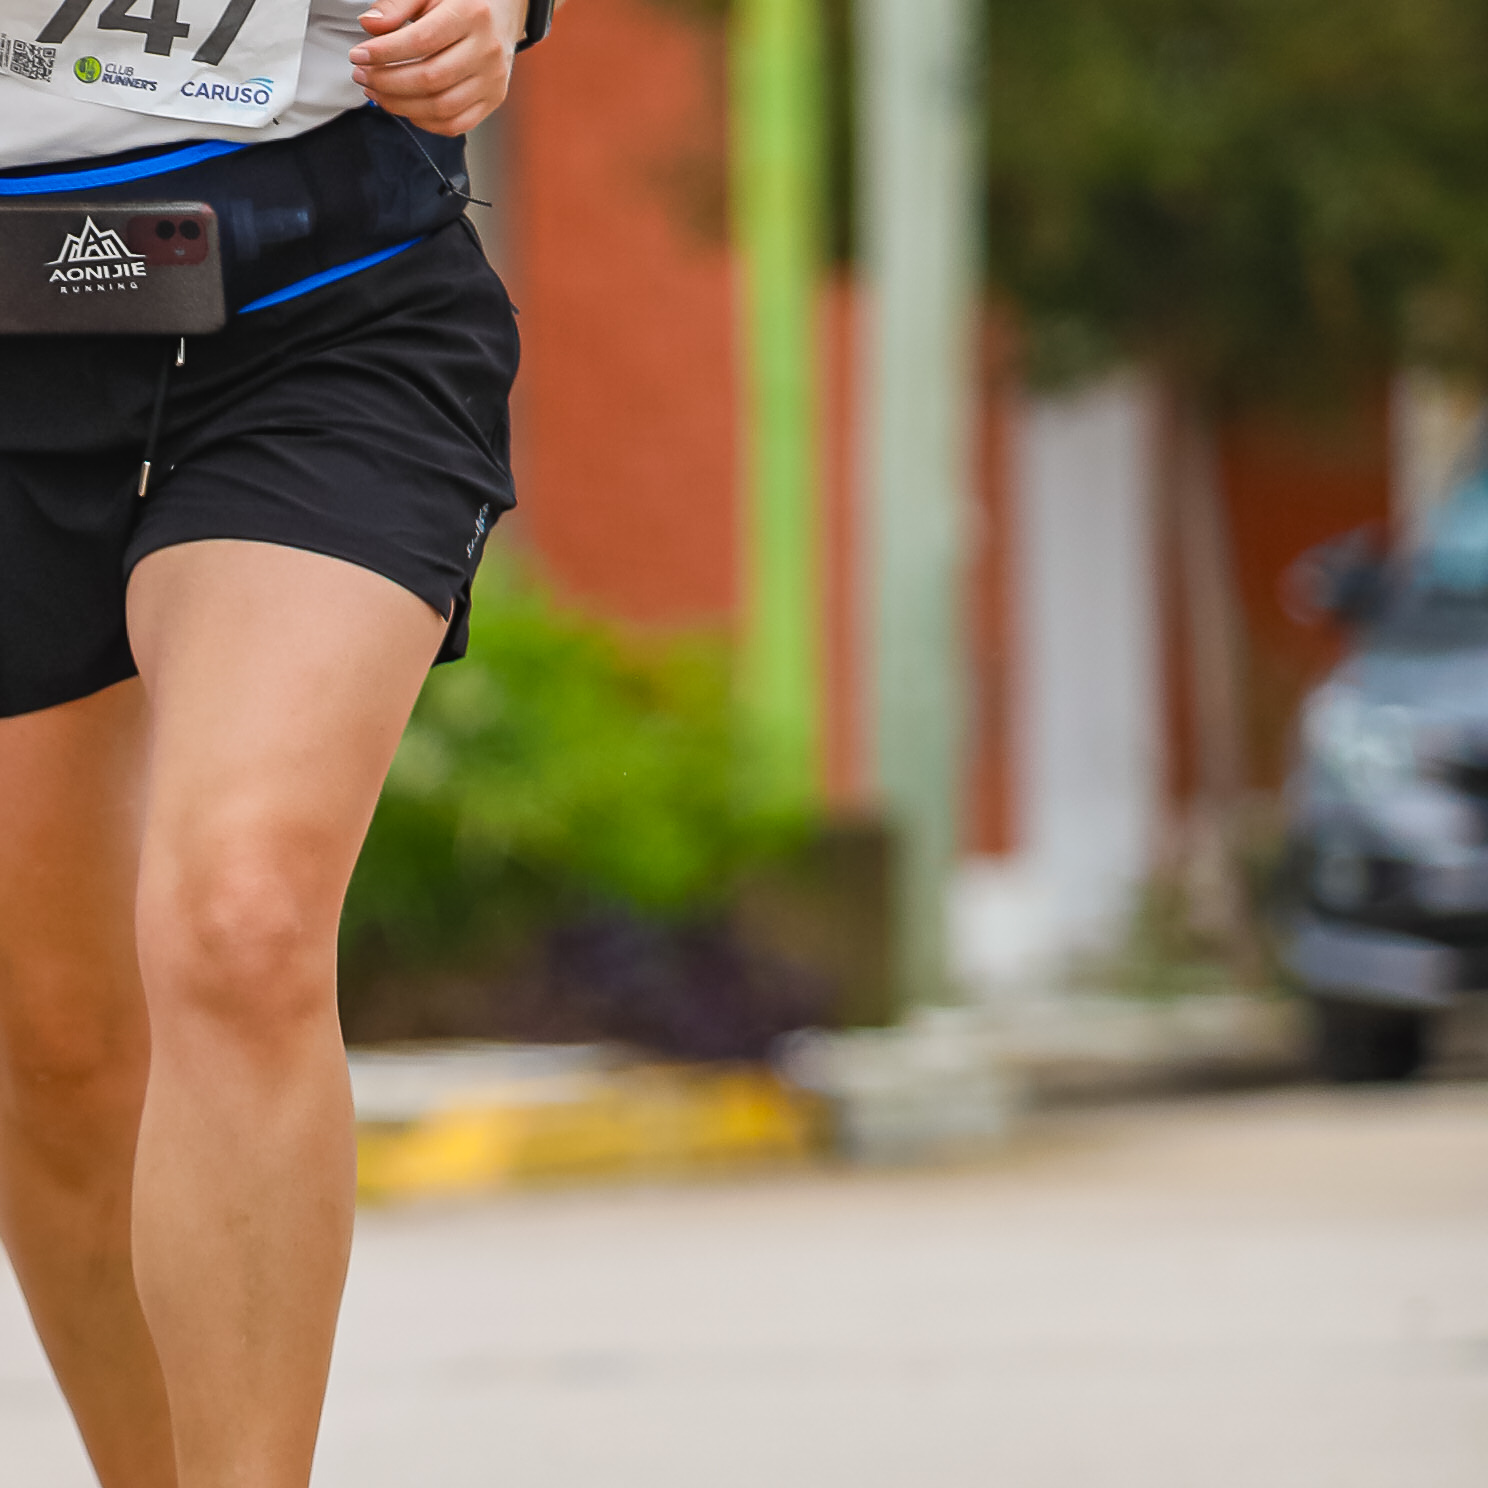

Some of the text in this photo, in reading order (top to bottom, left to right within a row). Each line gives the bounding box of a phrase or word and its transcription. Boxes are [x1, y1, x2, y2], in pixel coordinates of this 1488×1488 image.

[105, 63, 134, 76] CLUB
[181, 81, 270, 105] CARUSO
[49, 261, 147, 282] AONIJIE
[60, 281, 139, 294] RUNNING
